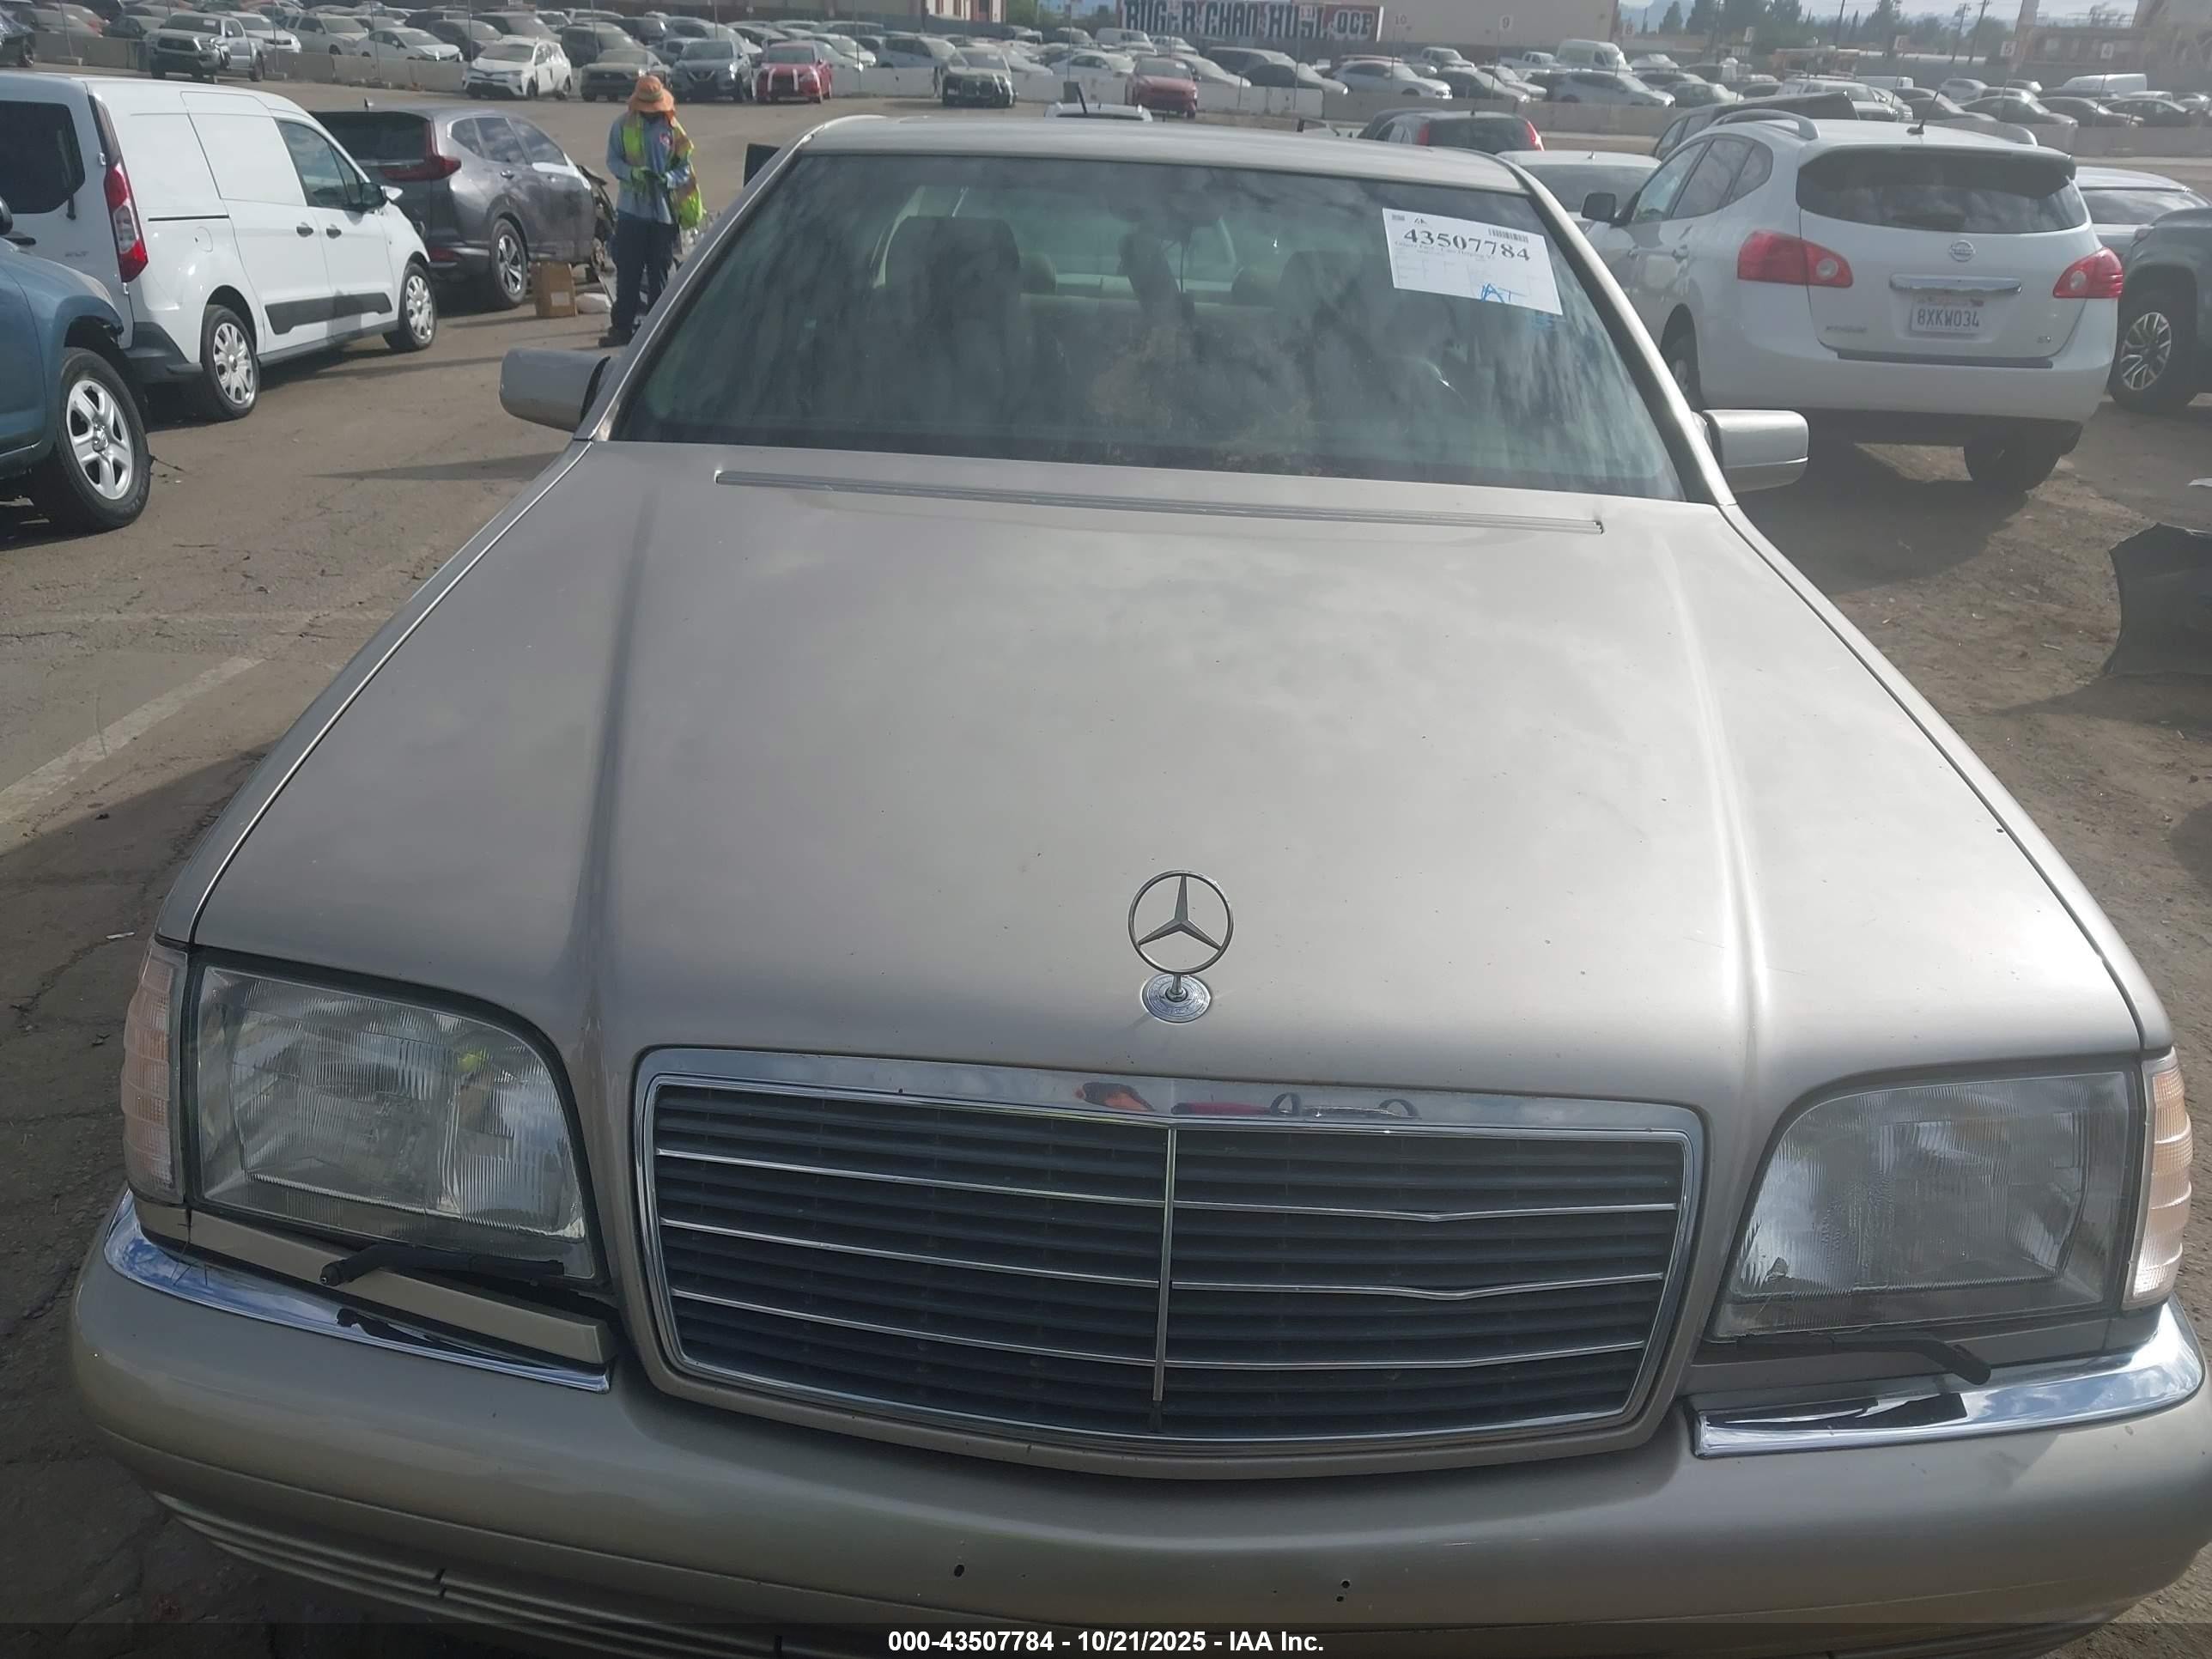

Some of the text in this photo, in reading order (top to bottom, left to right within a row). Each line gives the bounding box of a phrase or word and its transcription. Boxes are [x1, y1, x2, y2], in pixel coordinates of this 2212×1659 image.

[1395, 14, 1407, 26] 10
[1403, 228, 1531, 262] 43507784
[1917, 308, 1980, 327] 8XKW034
